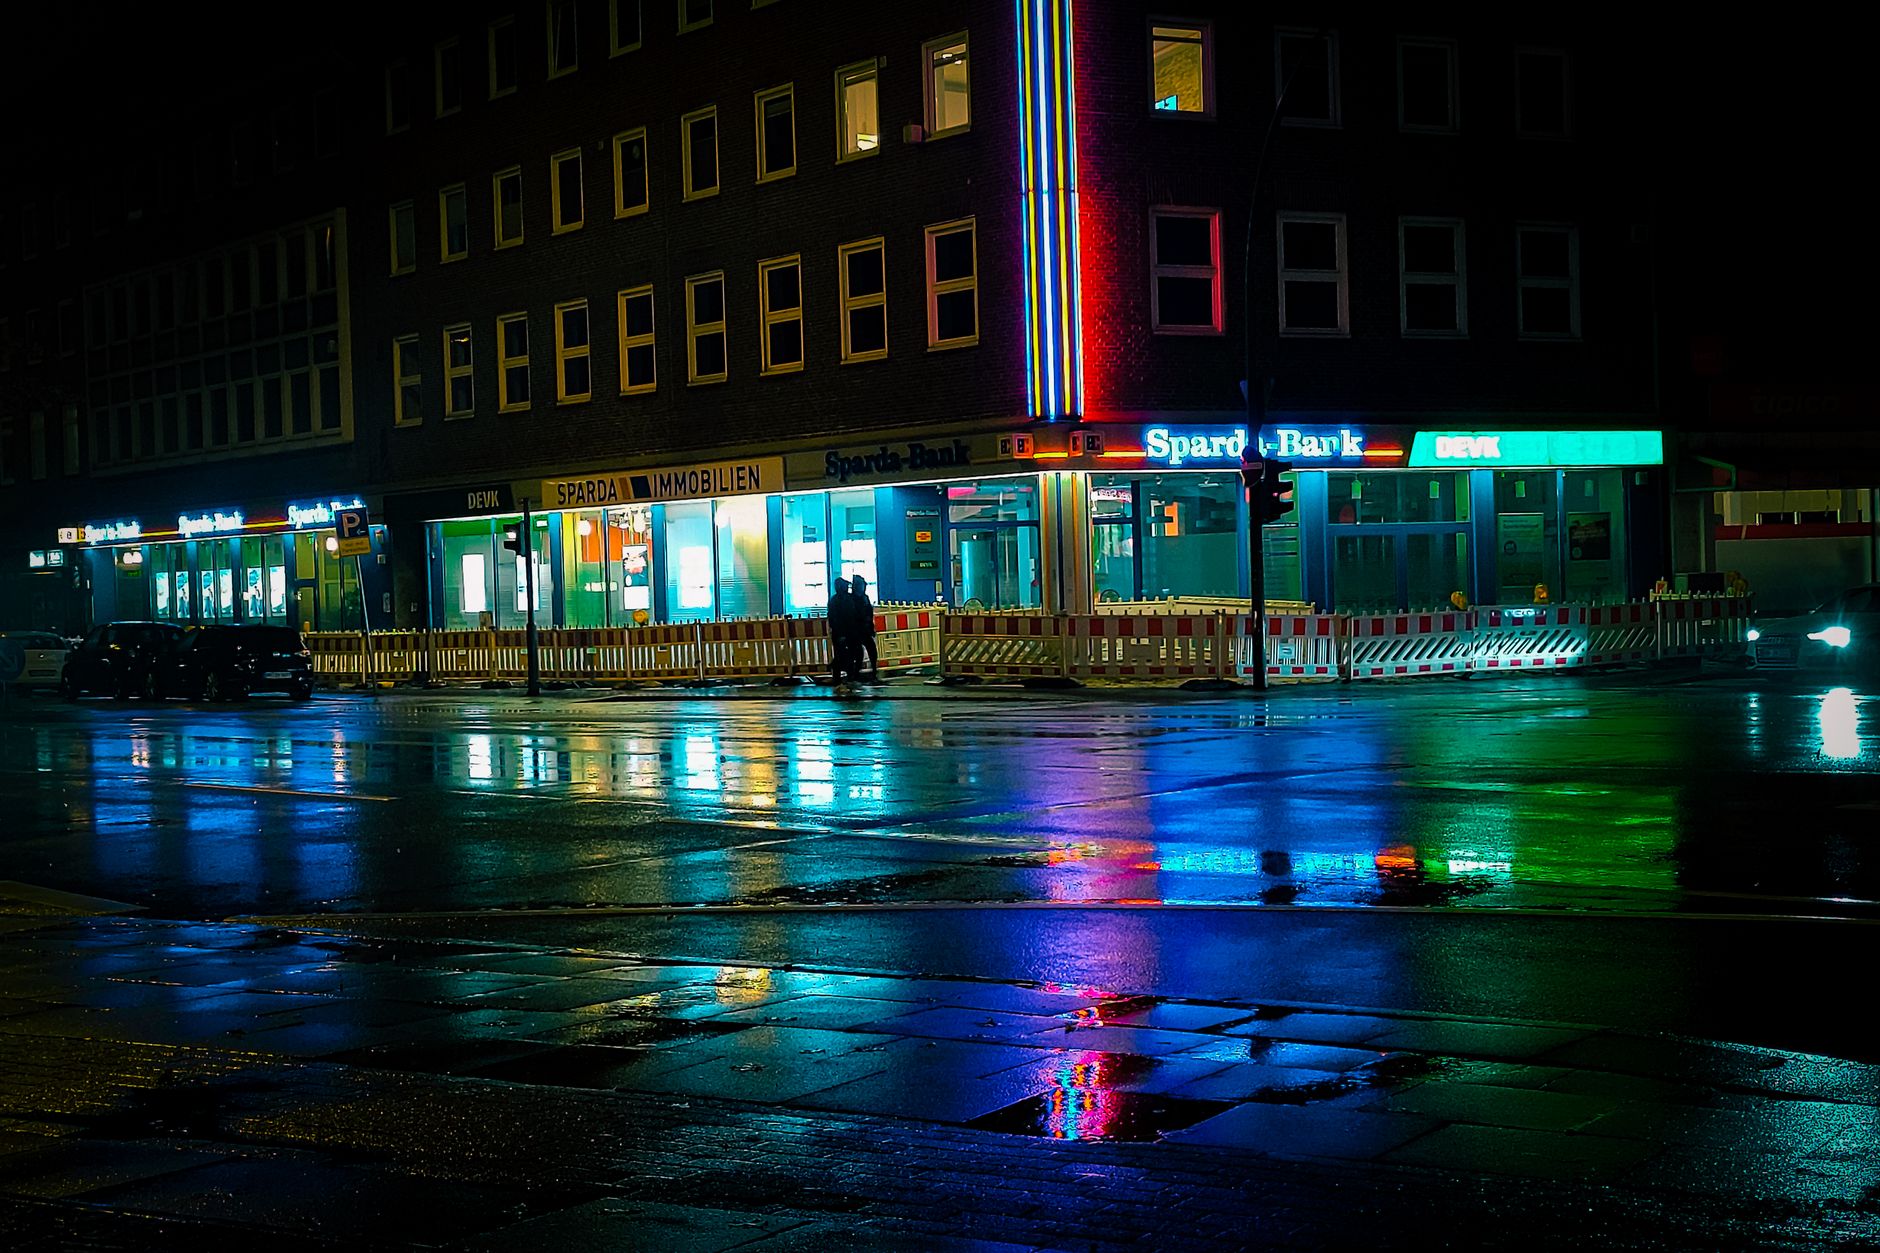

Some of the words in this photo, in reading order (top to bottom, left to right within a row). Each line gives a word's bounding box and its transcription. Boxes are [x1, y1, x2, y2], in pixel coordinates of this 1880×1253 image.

[1435, 435, 1501, 459] DEVK
[825, 438, 970, 483] Sparda-Bank
[557, 478, 618, 505] SPARDA
[653, 464, 761, 498] IMMOBILIEN
[467, 490, 500, 510] DEVK
[342, 513, 360, 538] P
